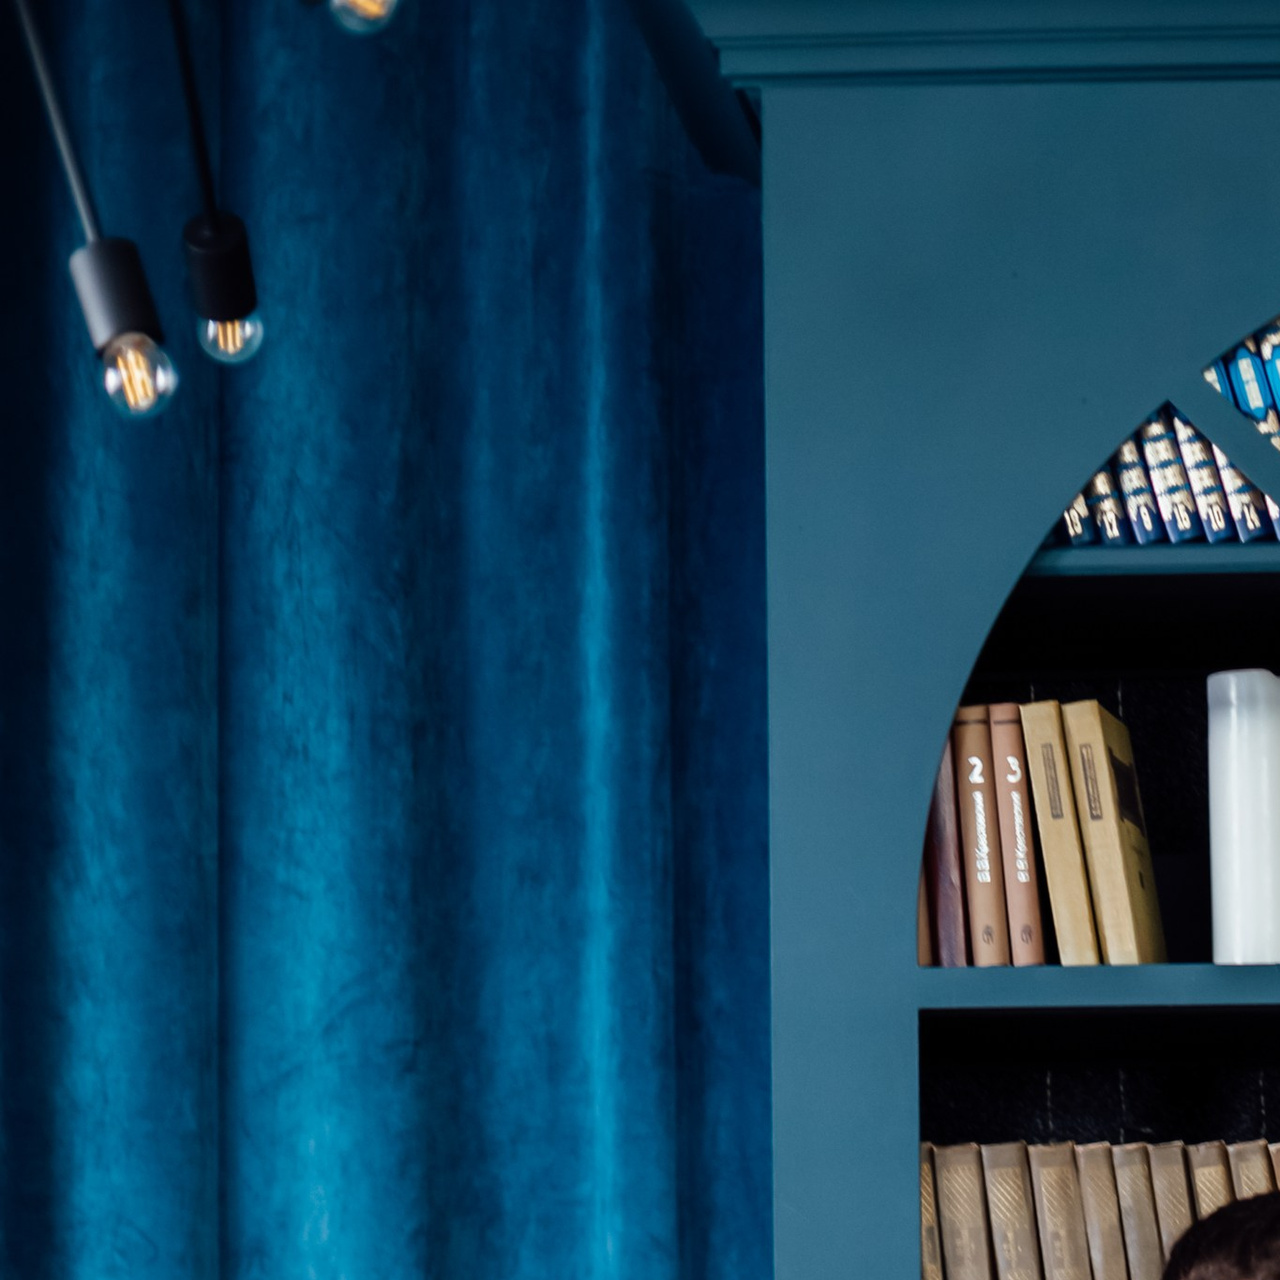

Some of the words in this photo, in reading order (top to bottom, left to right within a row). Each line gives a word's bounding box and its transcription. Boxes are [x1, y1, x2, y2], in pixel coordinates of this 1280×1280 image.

[1207, 504, 1226, 532] 10
[968, 756, 984, 784] 2
[1006, 756, 1022, 783] 3
